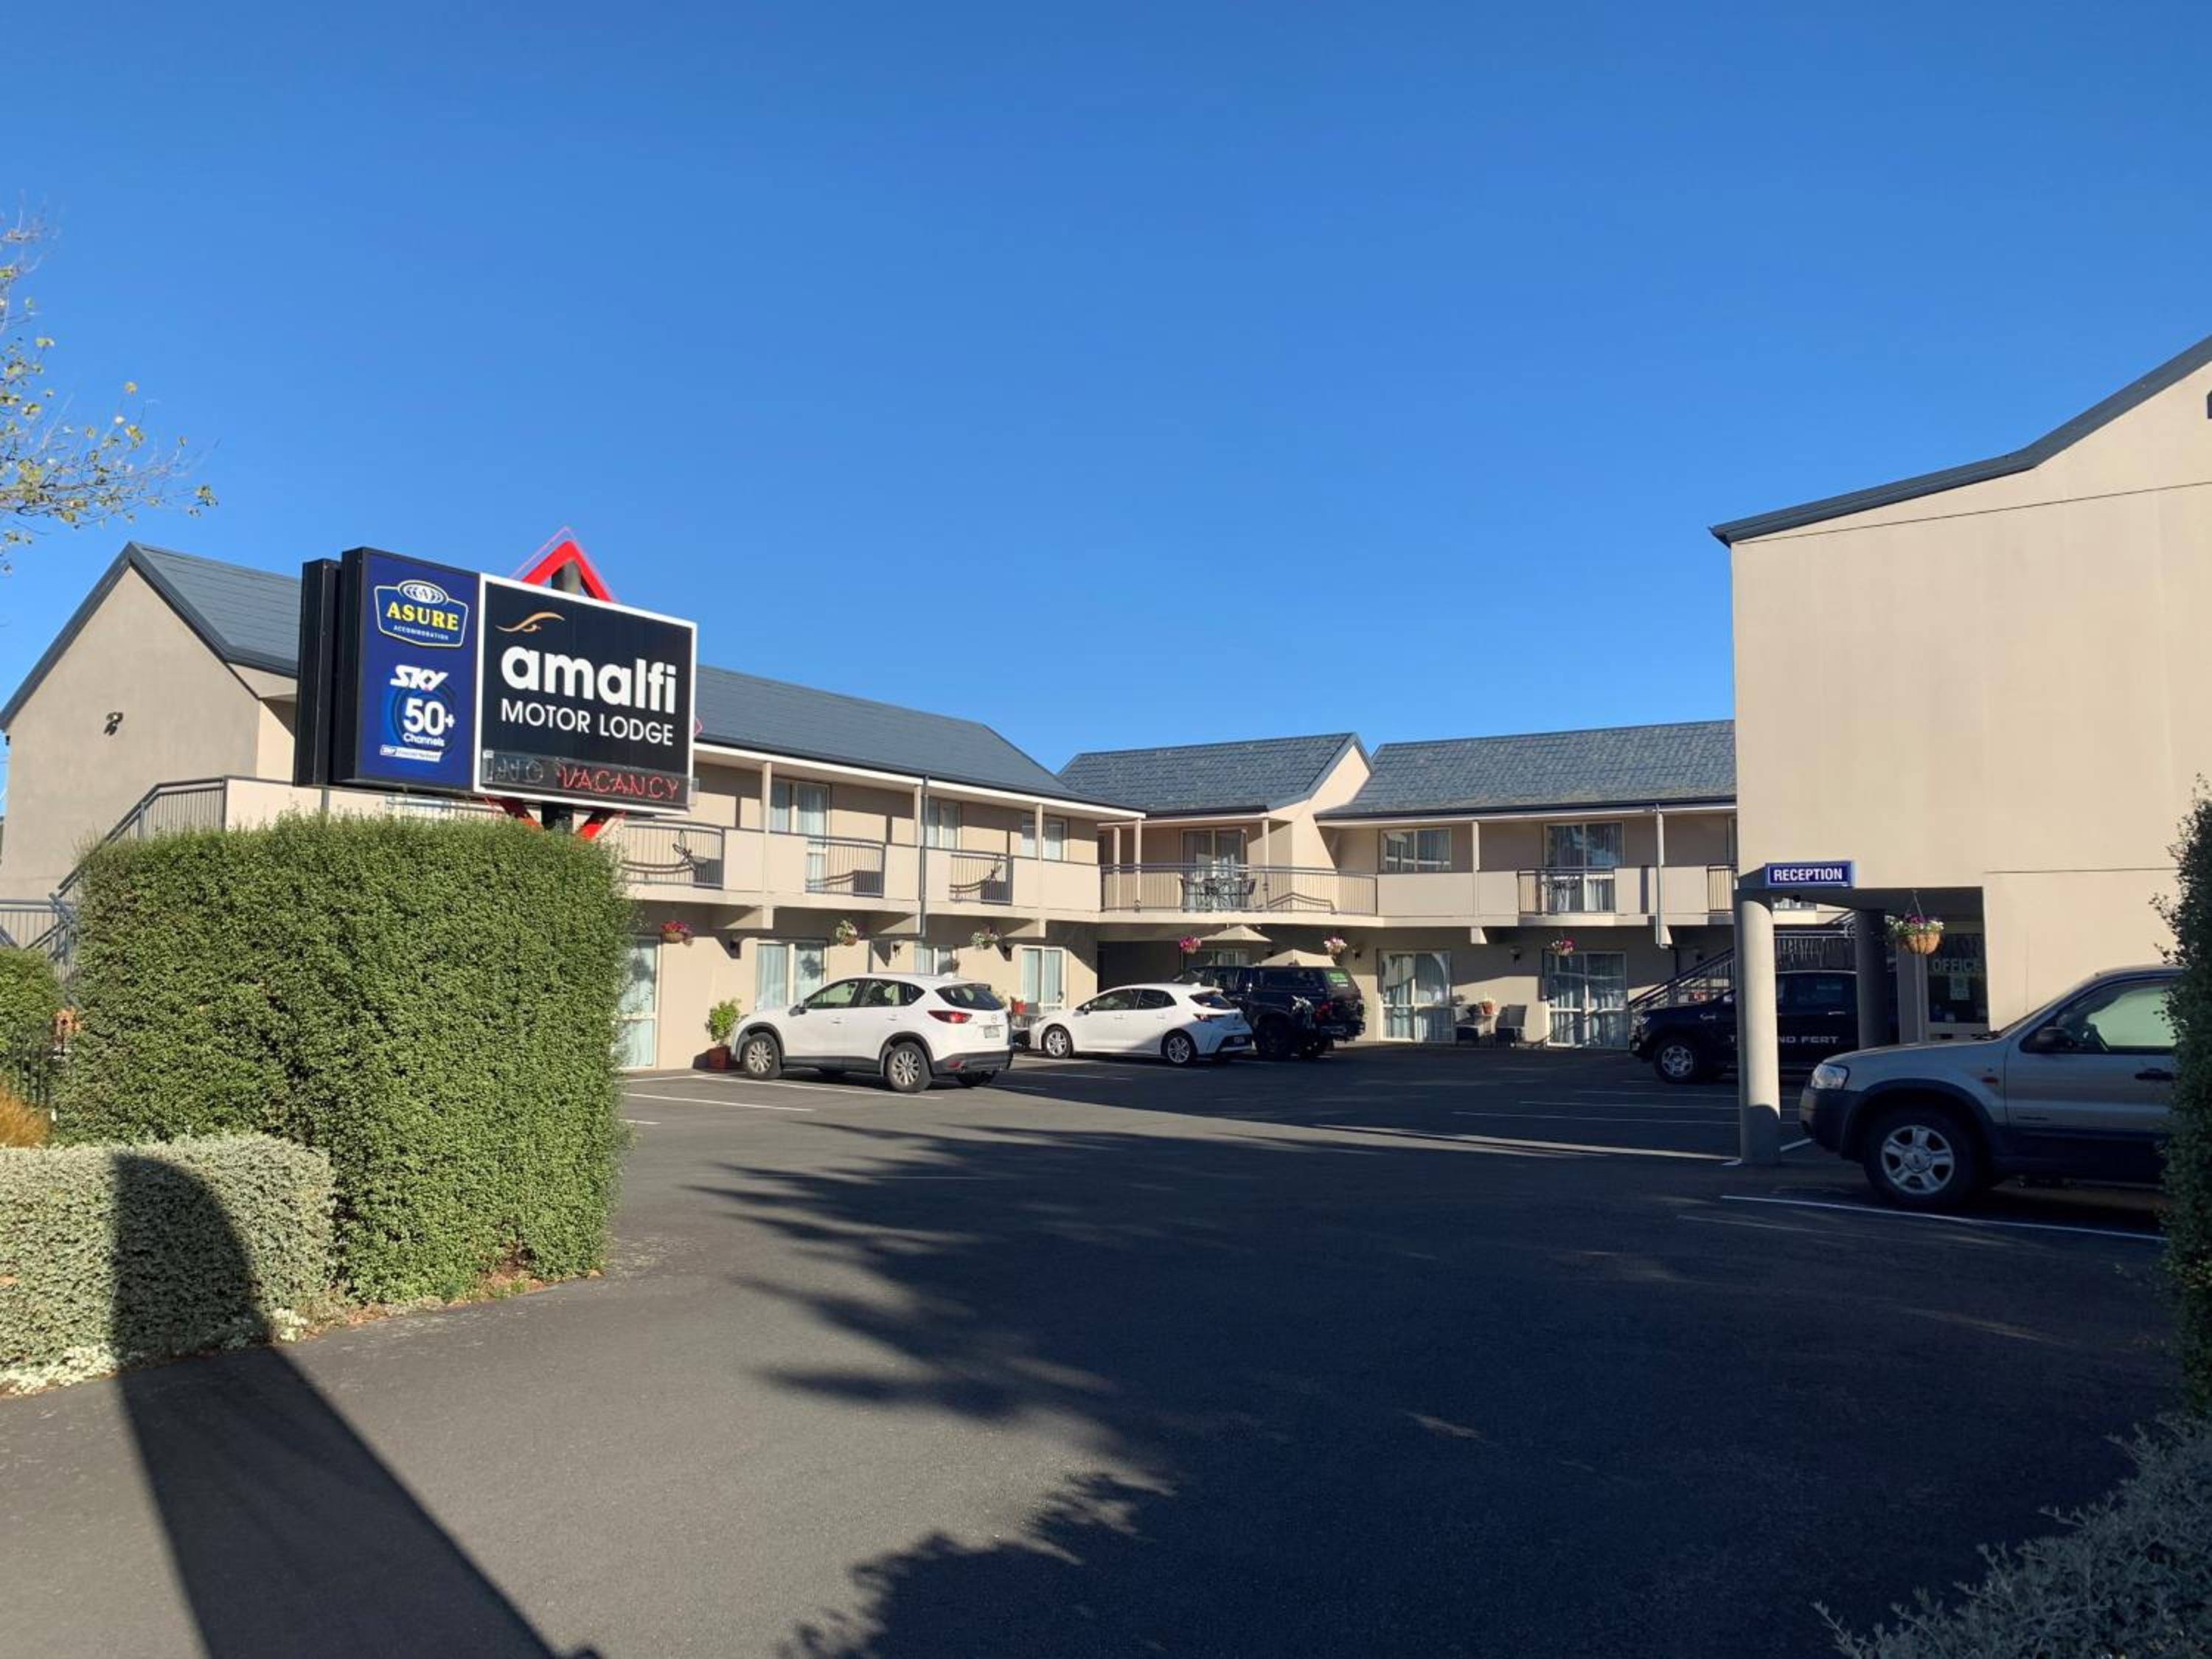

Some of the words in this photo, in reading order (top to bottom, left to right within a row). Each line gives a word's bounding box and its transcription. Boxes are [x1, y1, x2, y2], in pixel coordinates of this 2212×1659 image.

[386, 601, 459, 631] ASURE
[390, 664, 449, 692] SKY
[501, 645, 676, 714] amalfi
[403, 697, 455, 736] 50+
[501, 698, 590, 734] MOTOR
[599, 713, 673, 746] LODGE
[403, 732, 445, 747] Channels
[559, 765, 679, 799] VACANCY
[1773, 868, 1843, 881] RECEPTION
[1933, 958, 1983, 973] OFFICE
